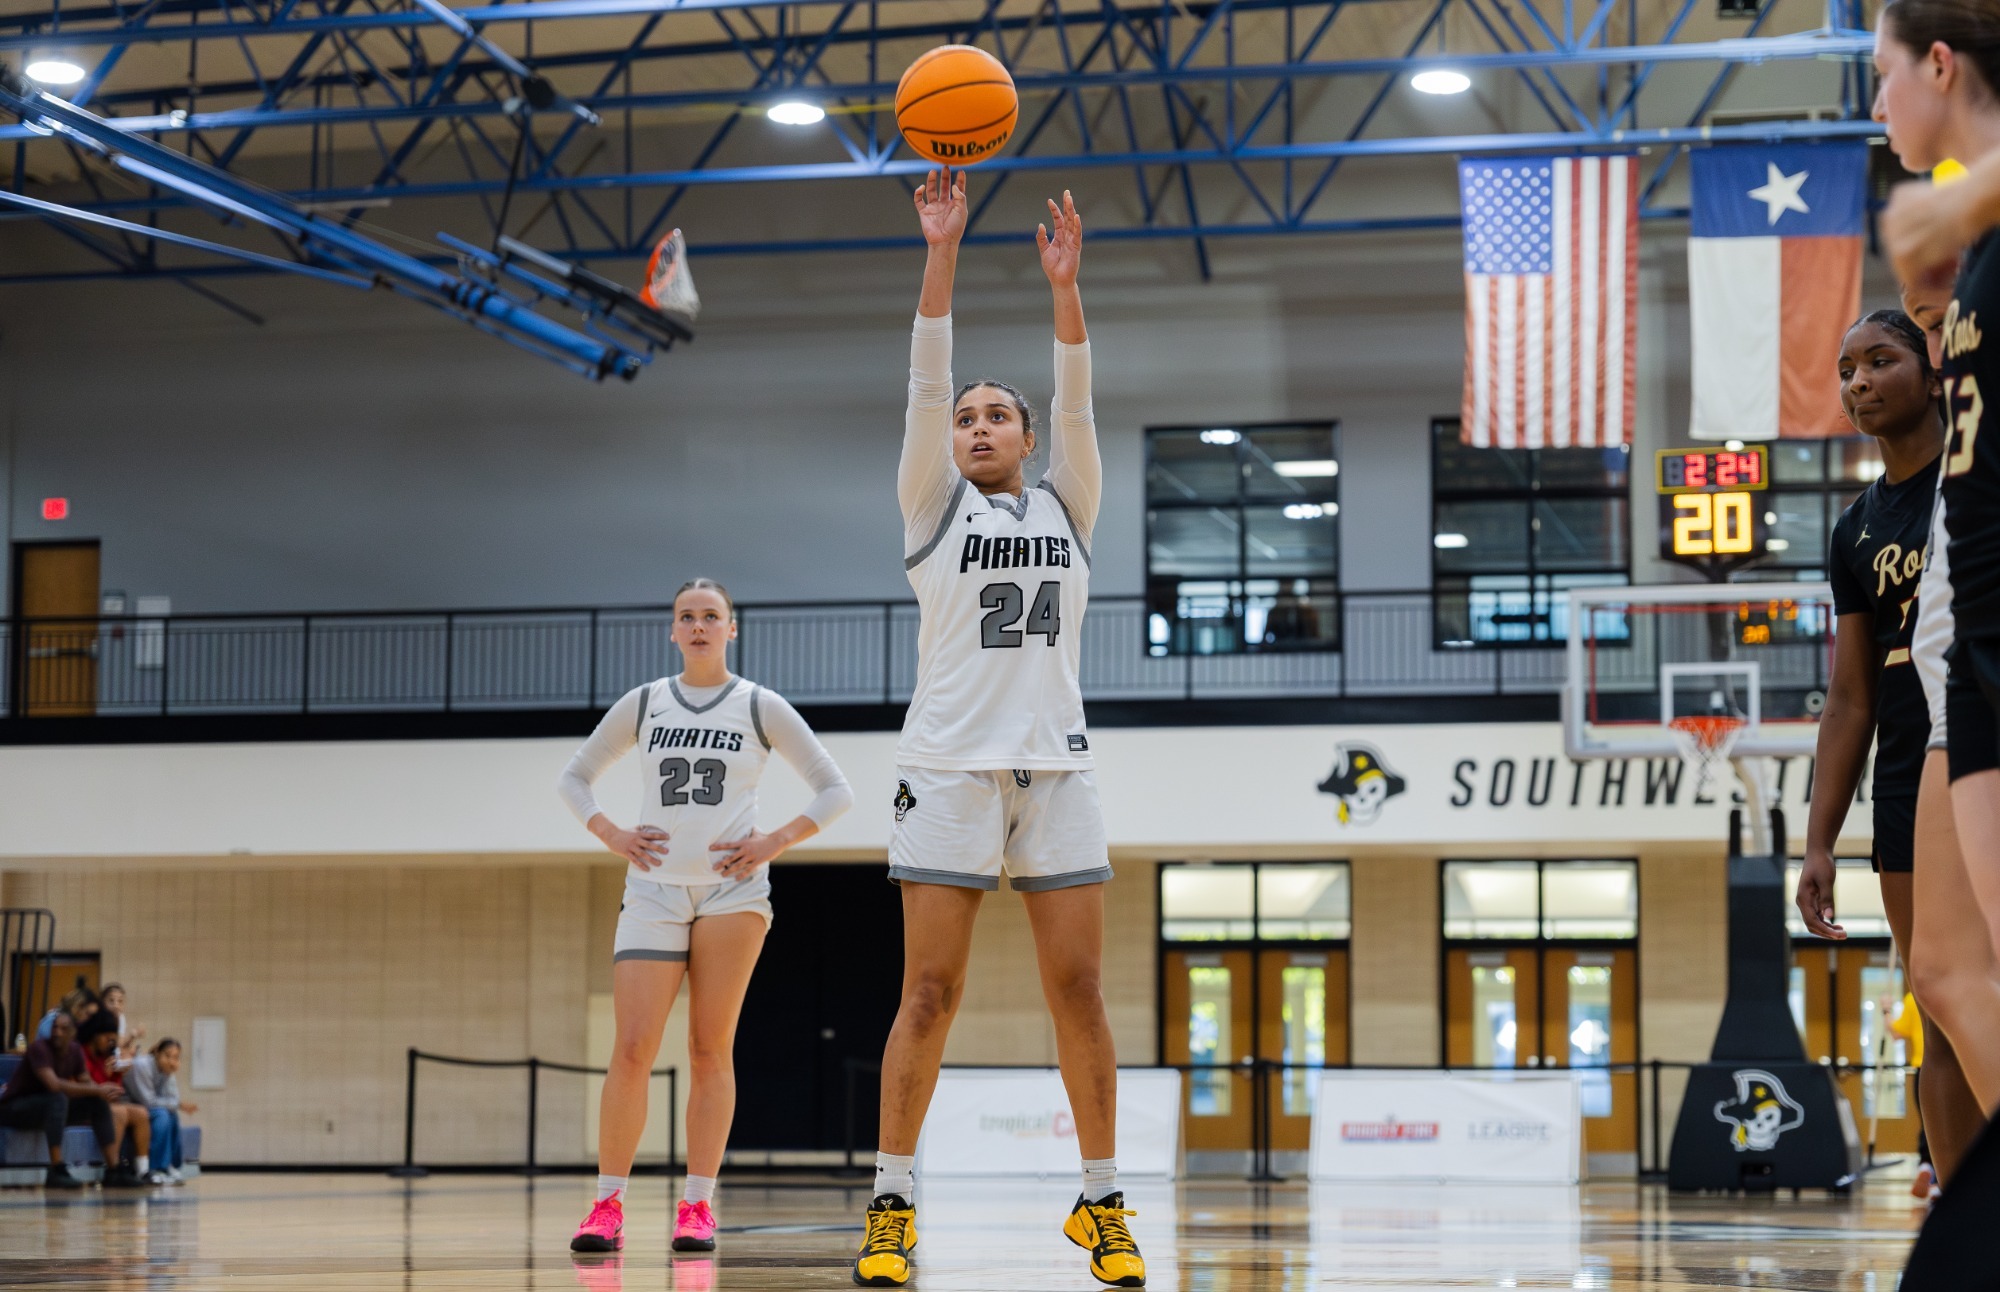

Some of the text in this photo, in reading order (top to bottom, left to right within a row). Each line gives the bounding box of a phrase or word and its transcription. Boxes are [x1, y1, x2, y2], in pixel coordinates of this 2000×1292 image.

[931, 131, 1007, 157] Wilson
[1673, 492, 1752, 554] 20
[960, 534, 1071, 573] PIRATES
[980, 581, 1061, 649] 24
[648, 727, 743, 753] PIRATES
[660, 757, 726, 806] 23
